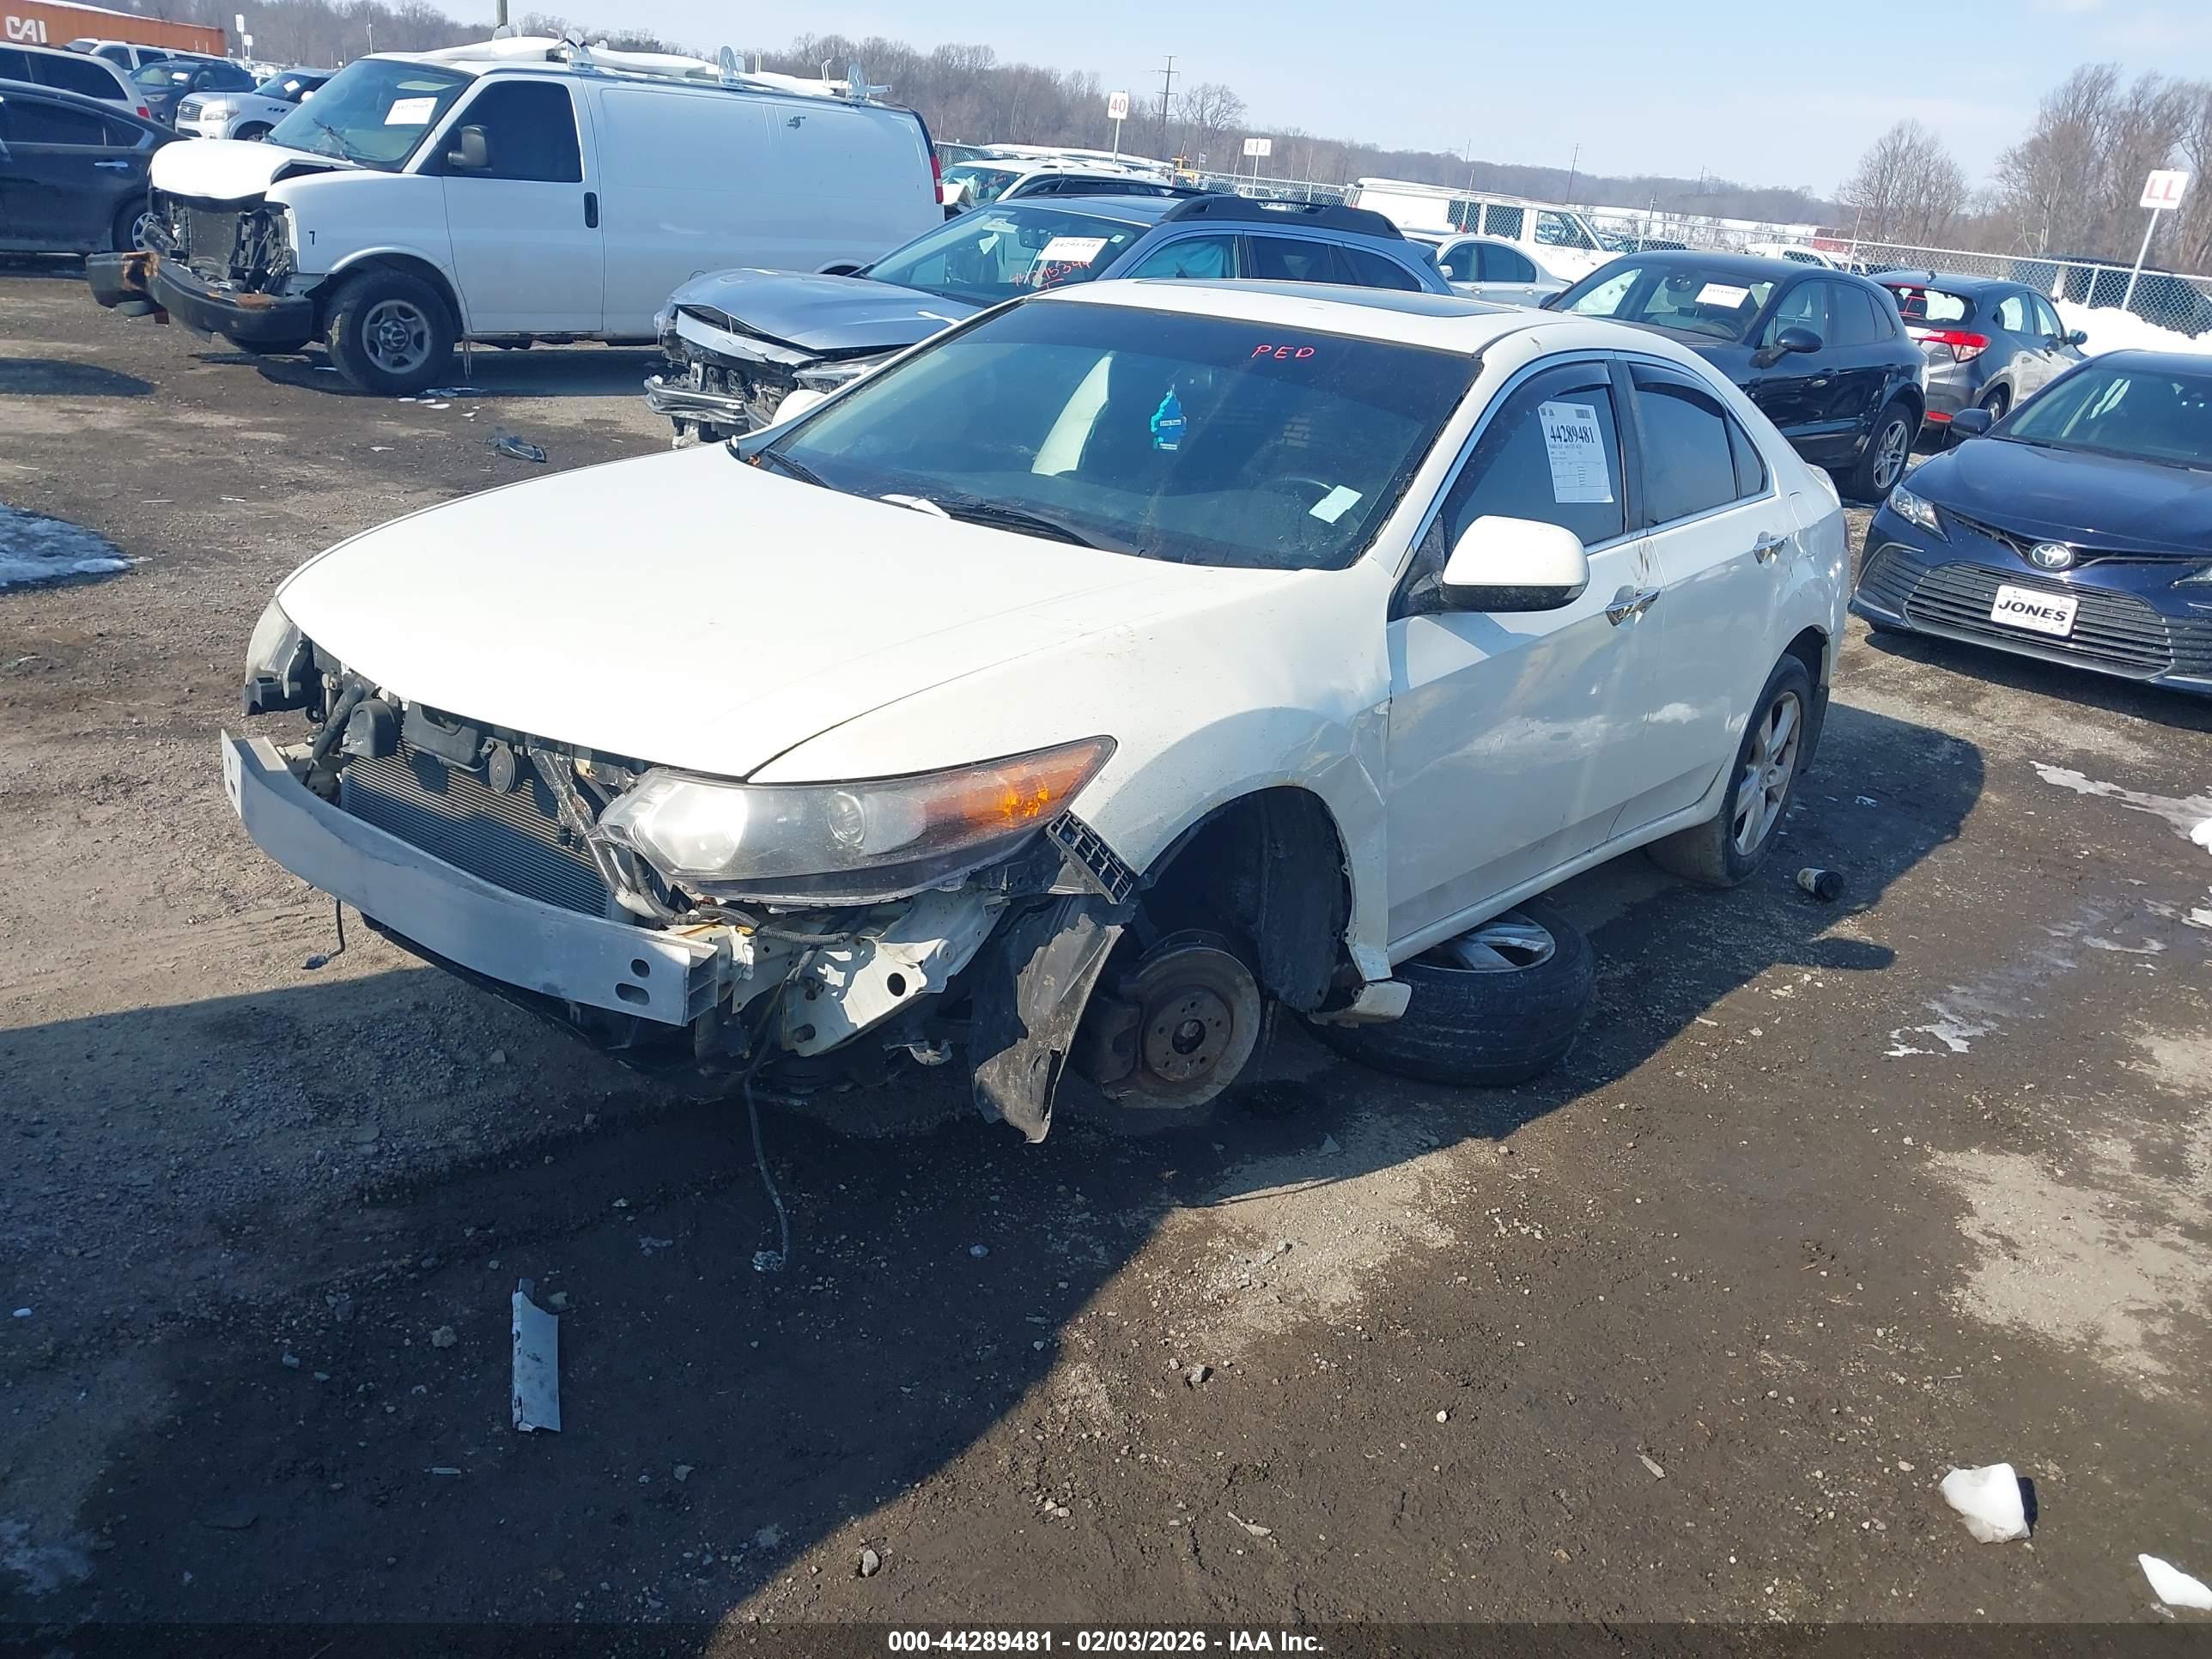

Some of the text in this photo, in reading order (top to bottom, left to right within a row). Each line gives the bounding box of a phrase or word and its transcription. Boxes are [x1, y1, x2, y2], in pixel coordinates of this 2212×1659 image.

[5, 15, 47, 43] CAI
[1110, 98, 1126, 113] 40
[2146, 178, 2177, 201] LL
[308, 230, 316, 246] 7
[1250, 344, 1315, 359] PED
[1550, 424, 1595, 444] 44289481
[1997, 599, 2069, 622] JONES
